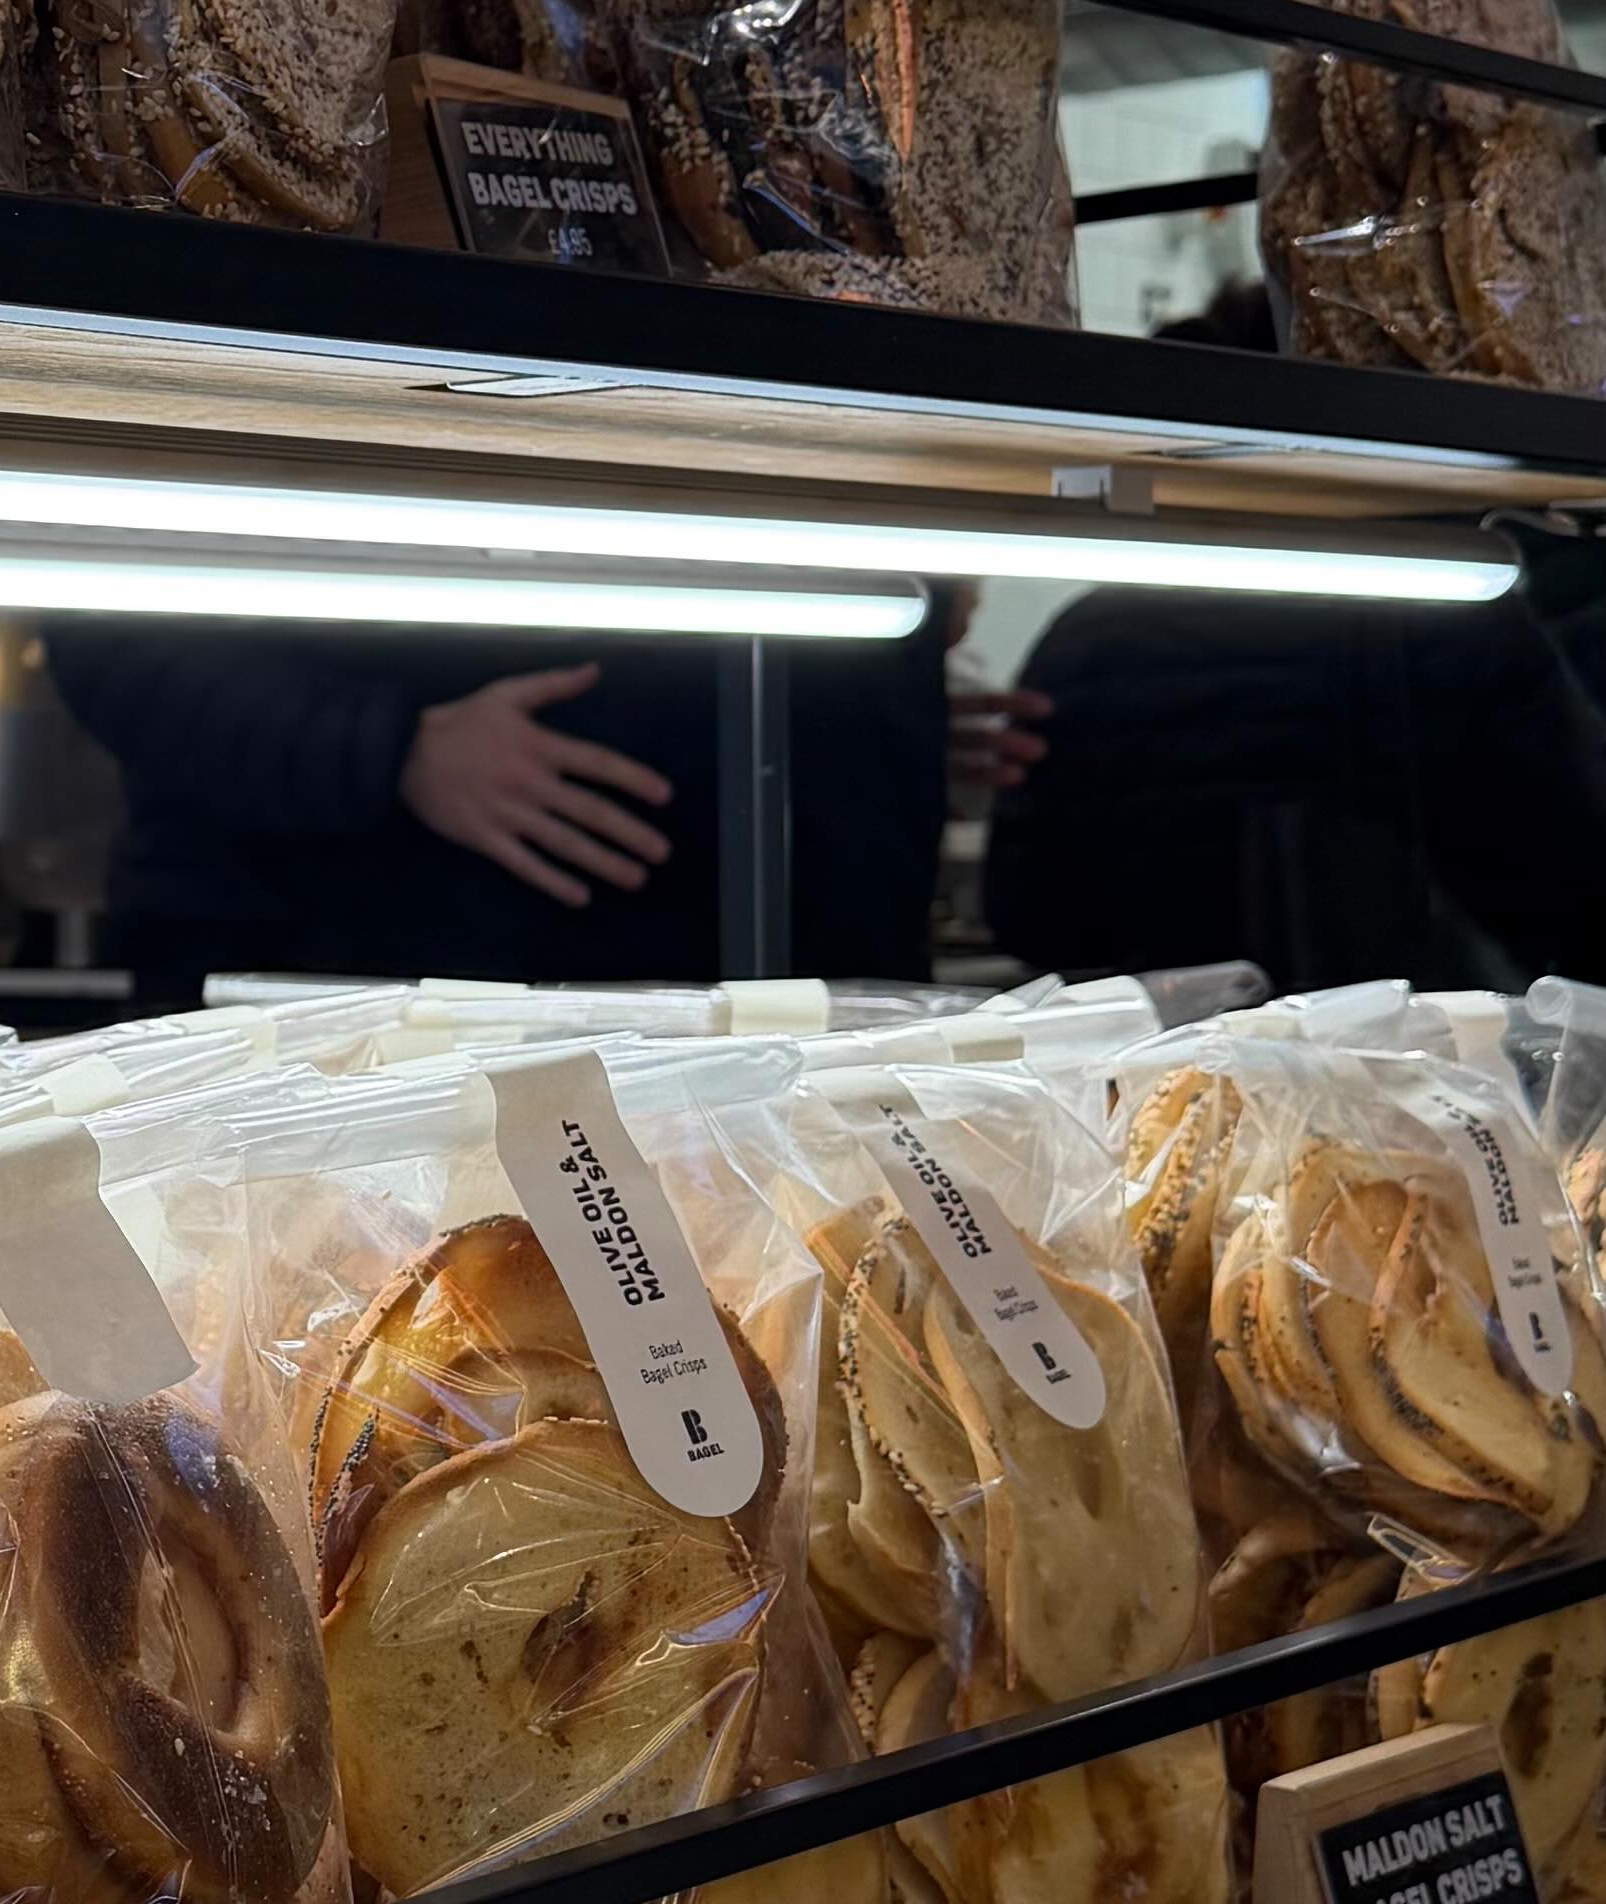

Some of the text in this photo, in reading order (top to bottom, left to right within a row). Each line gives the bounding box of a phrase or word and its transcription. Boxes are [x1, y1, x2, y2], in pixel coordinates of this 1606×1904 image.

[461, 121, 614, 166] EVERYTHING
[468, 173, 638, 216] BAGEL CRISPS
[907, 1155, 935, 1187] OIL
[561, 1119, 666, 1302] MALDON SALT
[924, 1157, 992, 1255] MALDON
[931, 1191, 979, 1258] OLIVE
[559, 1156, 644, 1307] OLIVE OIL &
[640, 1355, 708, 1386] Bagel Crisps
[649, 1339, 684, 1361] Baked
[687, 1443, 724, 1462] BAGEL
[1342, 1793, 1507, 1887] MALDON SALT
